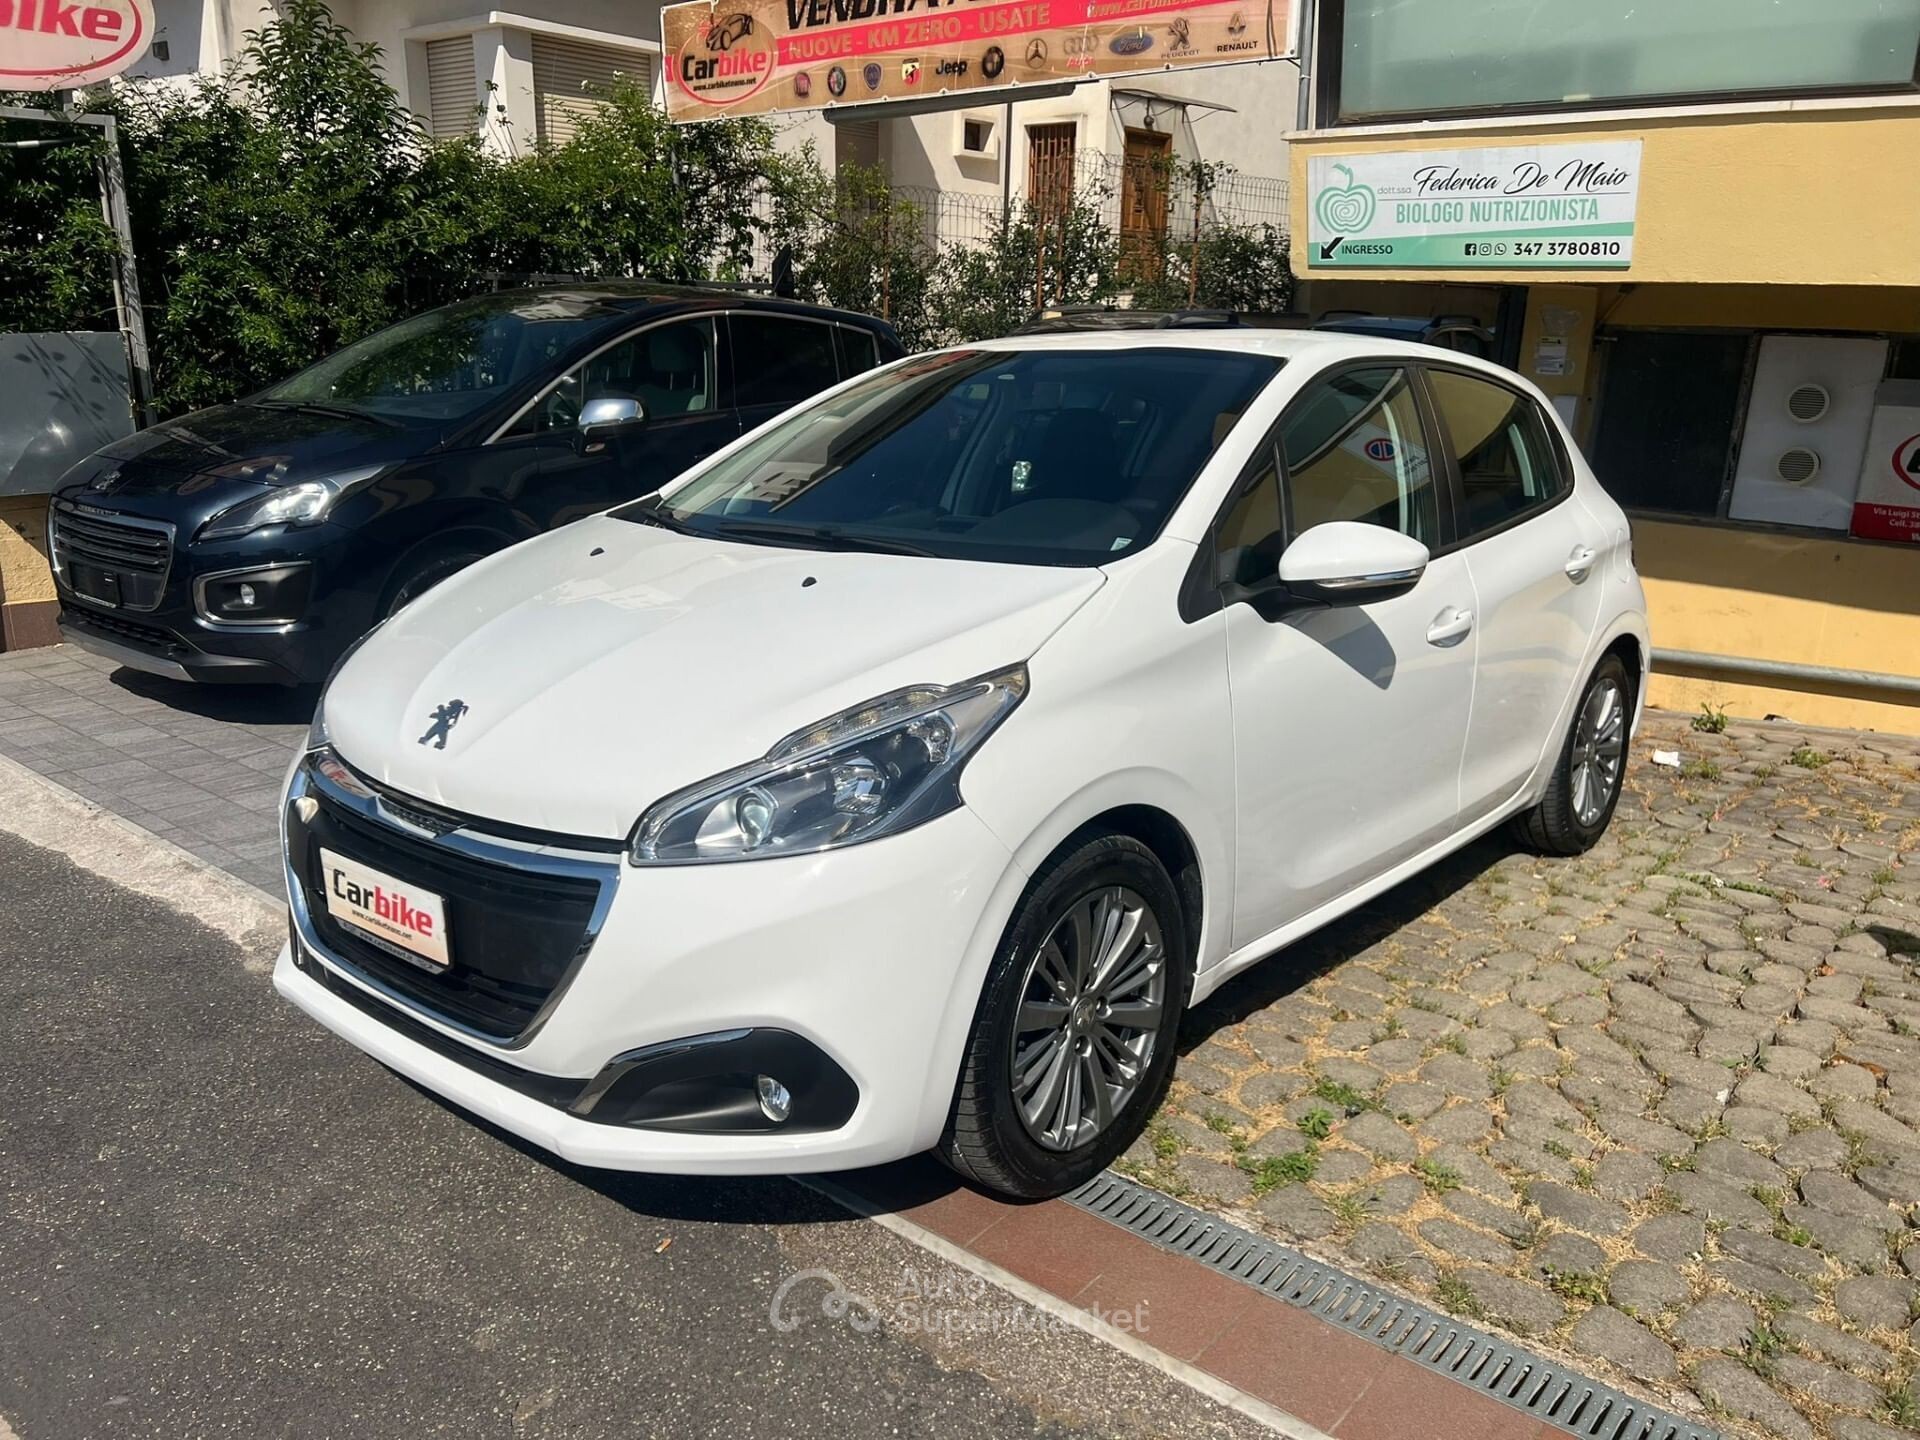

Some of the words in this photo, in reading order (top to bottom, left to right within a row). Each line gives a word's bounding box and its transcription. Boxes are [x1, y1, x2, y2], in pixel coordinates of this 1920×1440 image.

[0, 0, 122, 42] ike
[789, 33, 852, 59] NUOVE
[868, 26, 899, 49] KM
[904, 16, 961, 44] ZERO
[979, 3, 1050, 33] USATE
[1161, 50, 1200, 58] PEUGEOT
[1217, 41, 1258, 53] RENAULT
[683, 48, 767, 81] Carbike
[936, 59, 967, 76] Jeep
[1377, 186, 1412, 195] dott.ssa
[1413, 165, 1500, 197] Federica
[1503, 162, 1549, 195] De
[1554, 159, 1631, 193] Maio
[1396, 201, 1463, 224] BIOLOGO
[1470, 199, 1599, 222] NUTRIZIONISTA
[1341, 245, 1393, 255] INGRESSO
[1514, 243, 1542, 256] 347
[1547, 242, 1620, 256] 3780810
[333, 868, 433, 937] Carbike
